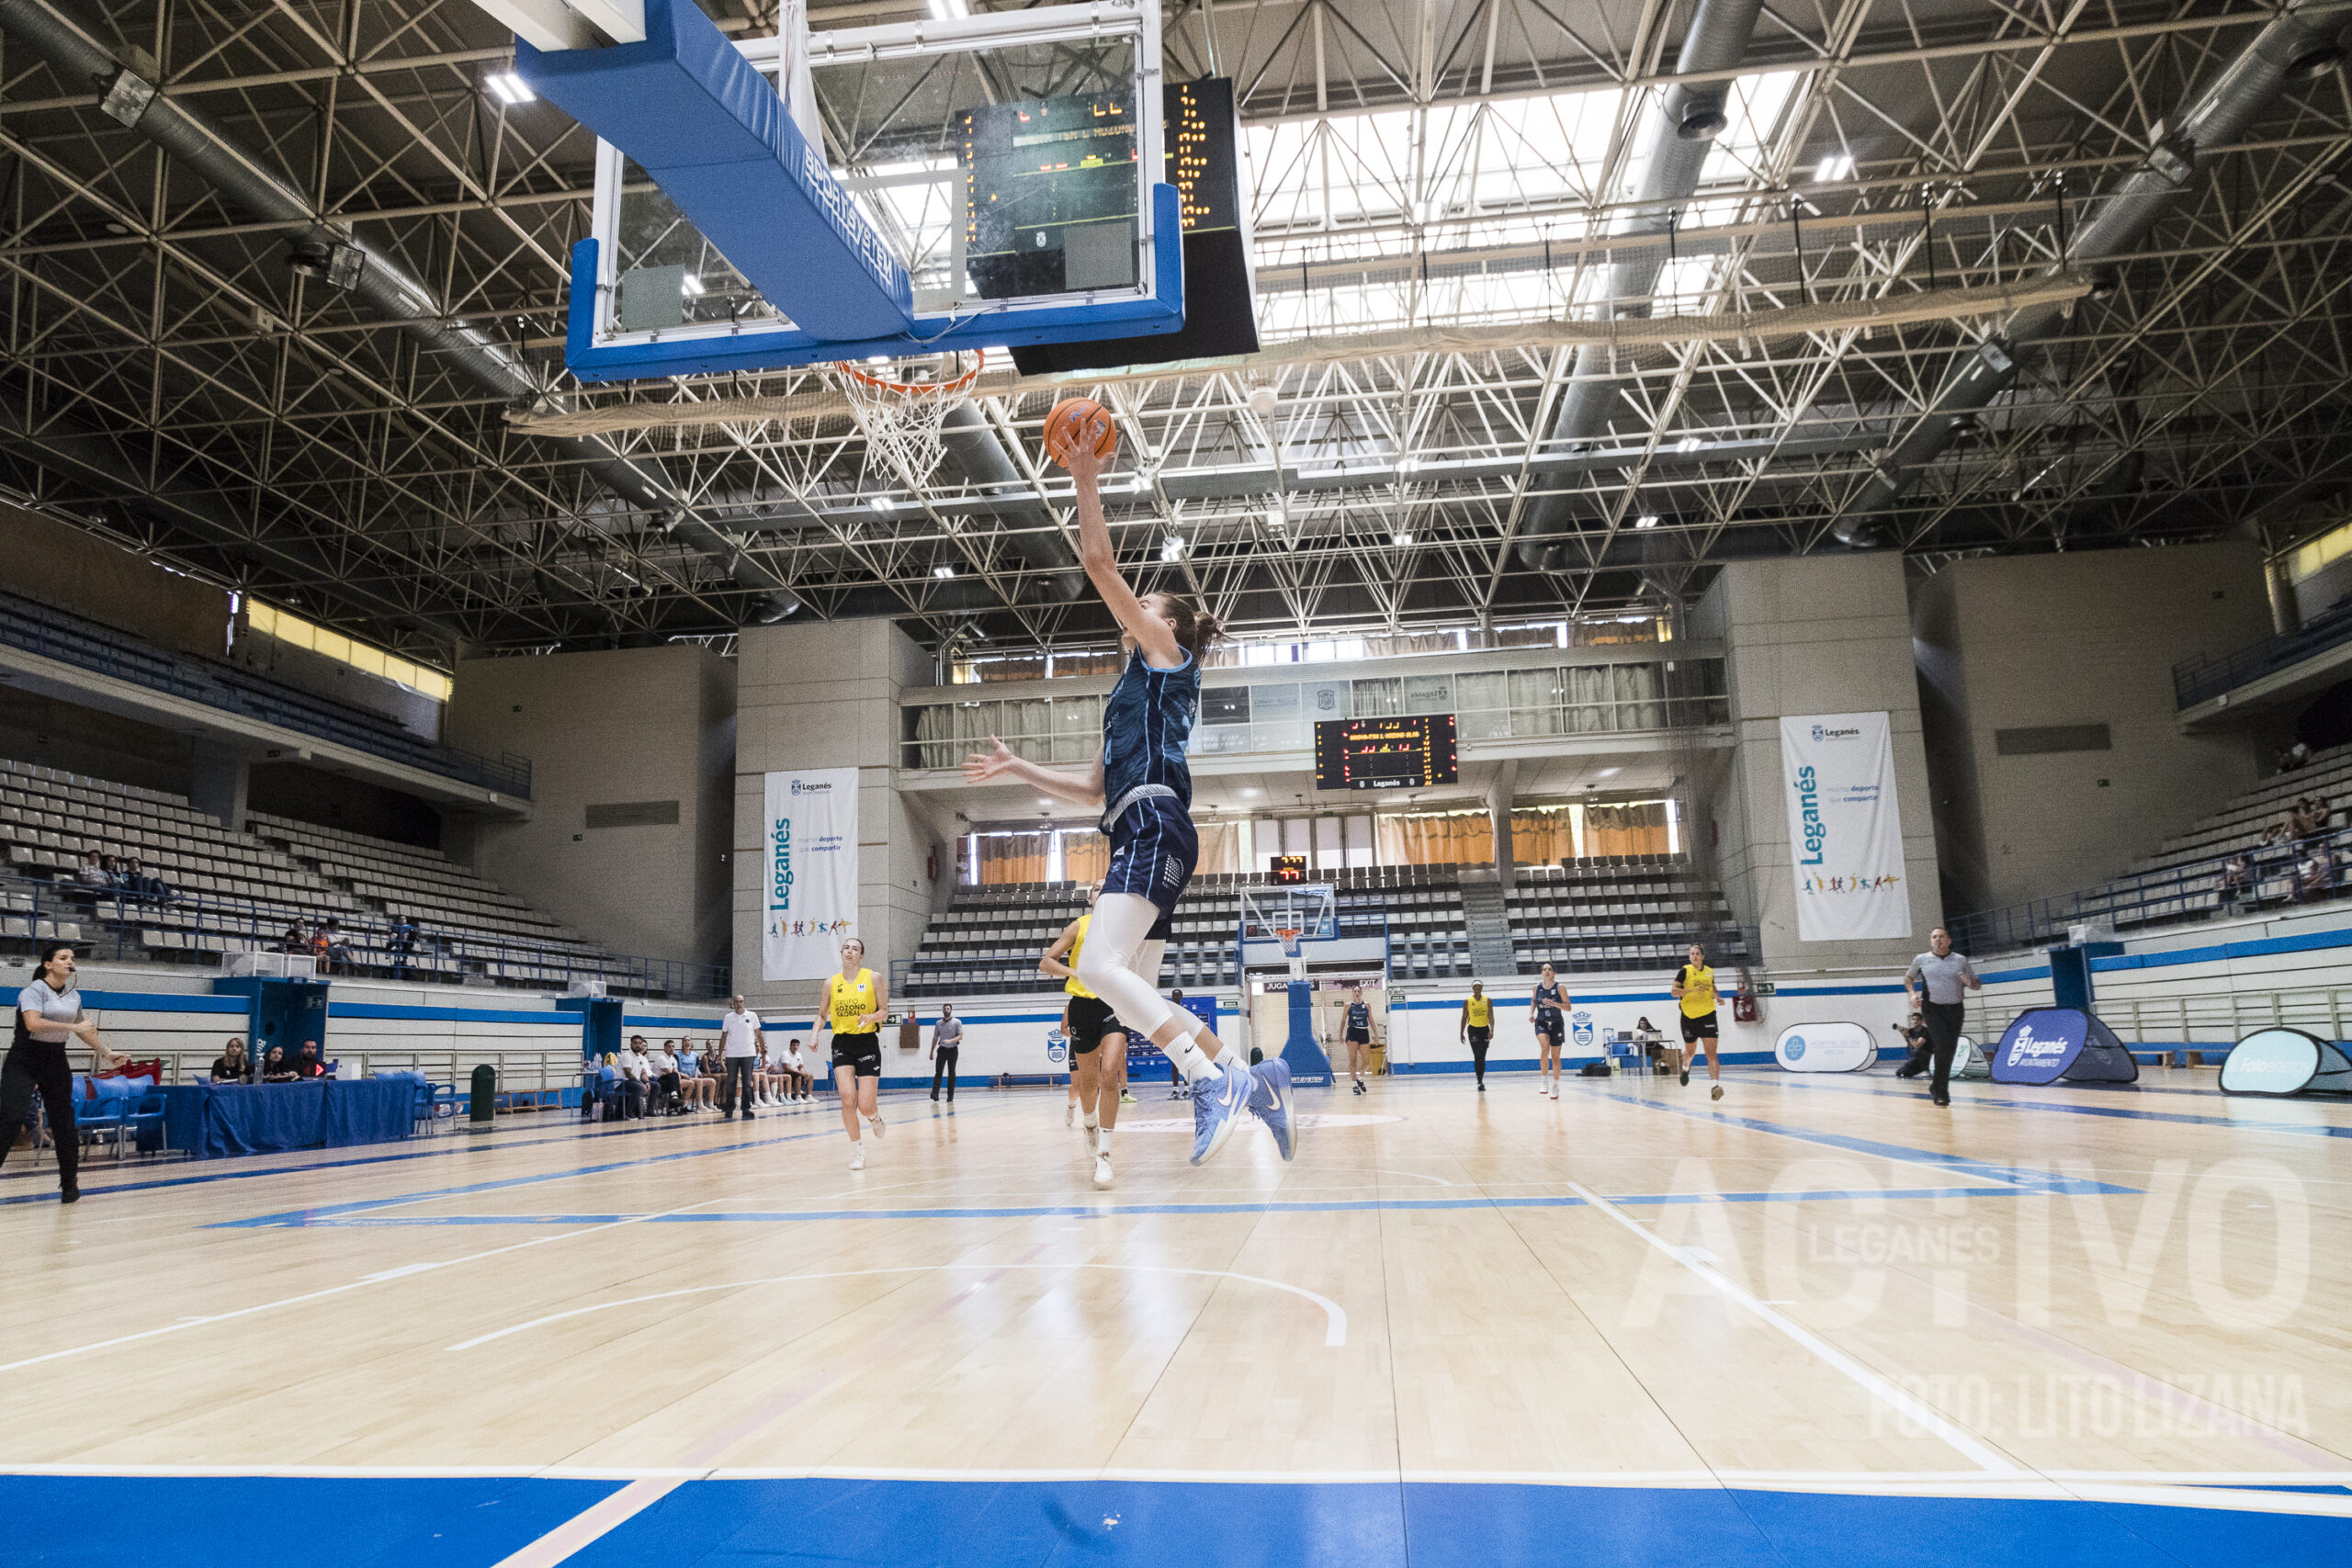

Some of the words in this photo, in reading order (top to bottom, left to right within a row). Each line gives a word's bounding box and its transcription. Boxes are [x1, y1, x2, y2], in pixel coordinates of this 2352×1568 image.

[1825, 728, 1860, 737] Leganés
[802, 782, 832, 792] Leganés
[1373, 779, 1400, 788] Leganés
[1793, 765, 1826, 866] Leganés
[819, 835, 843, 843] deporte
[811, 844, 841, 852] compartir
[769, 818, 795, 911] Leganés
[835, 1003, 866, 1013] HOZONO
[2024, 1036, 2069, 1057] Leganés
